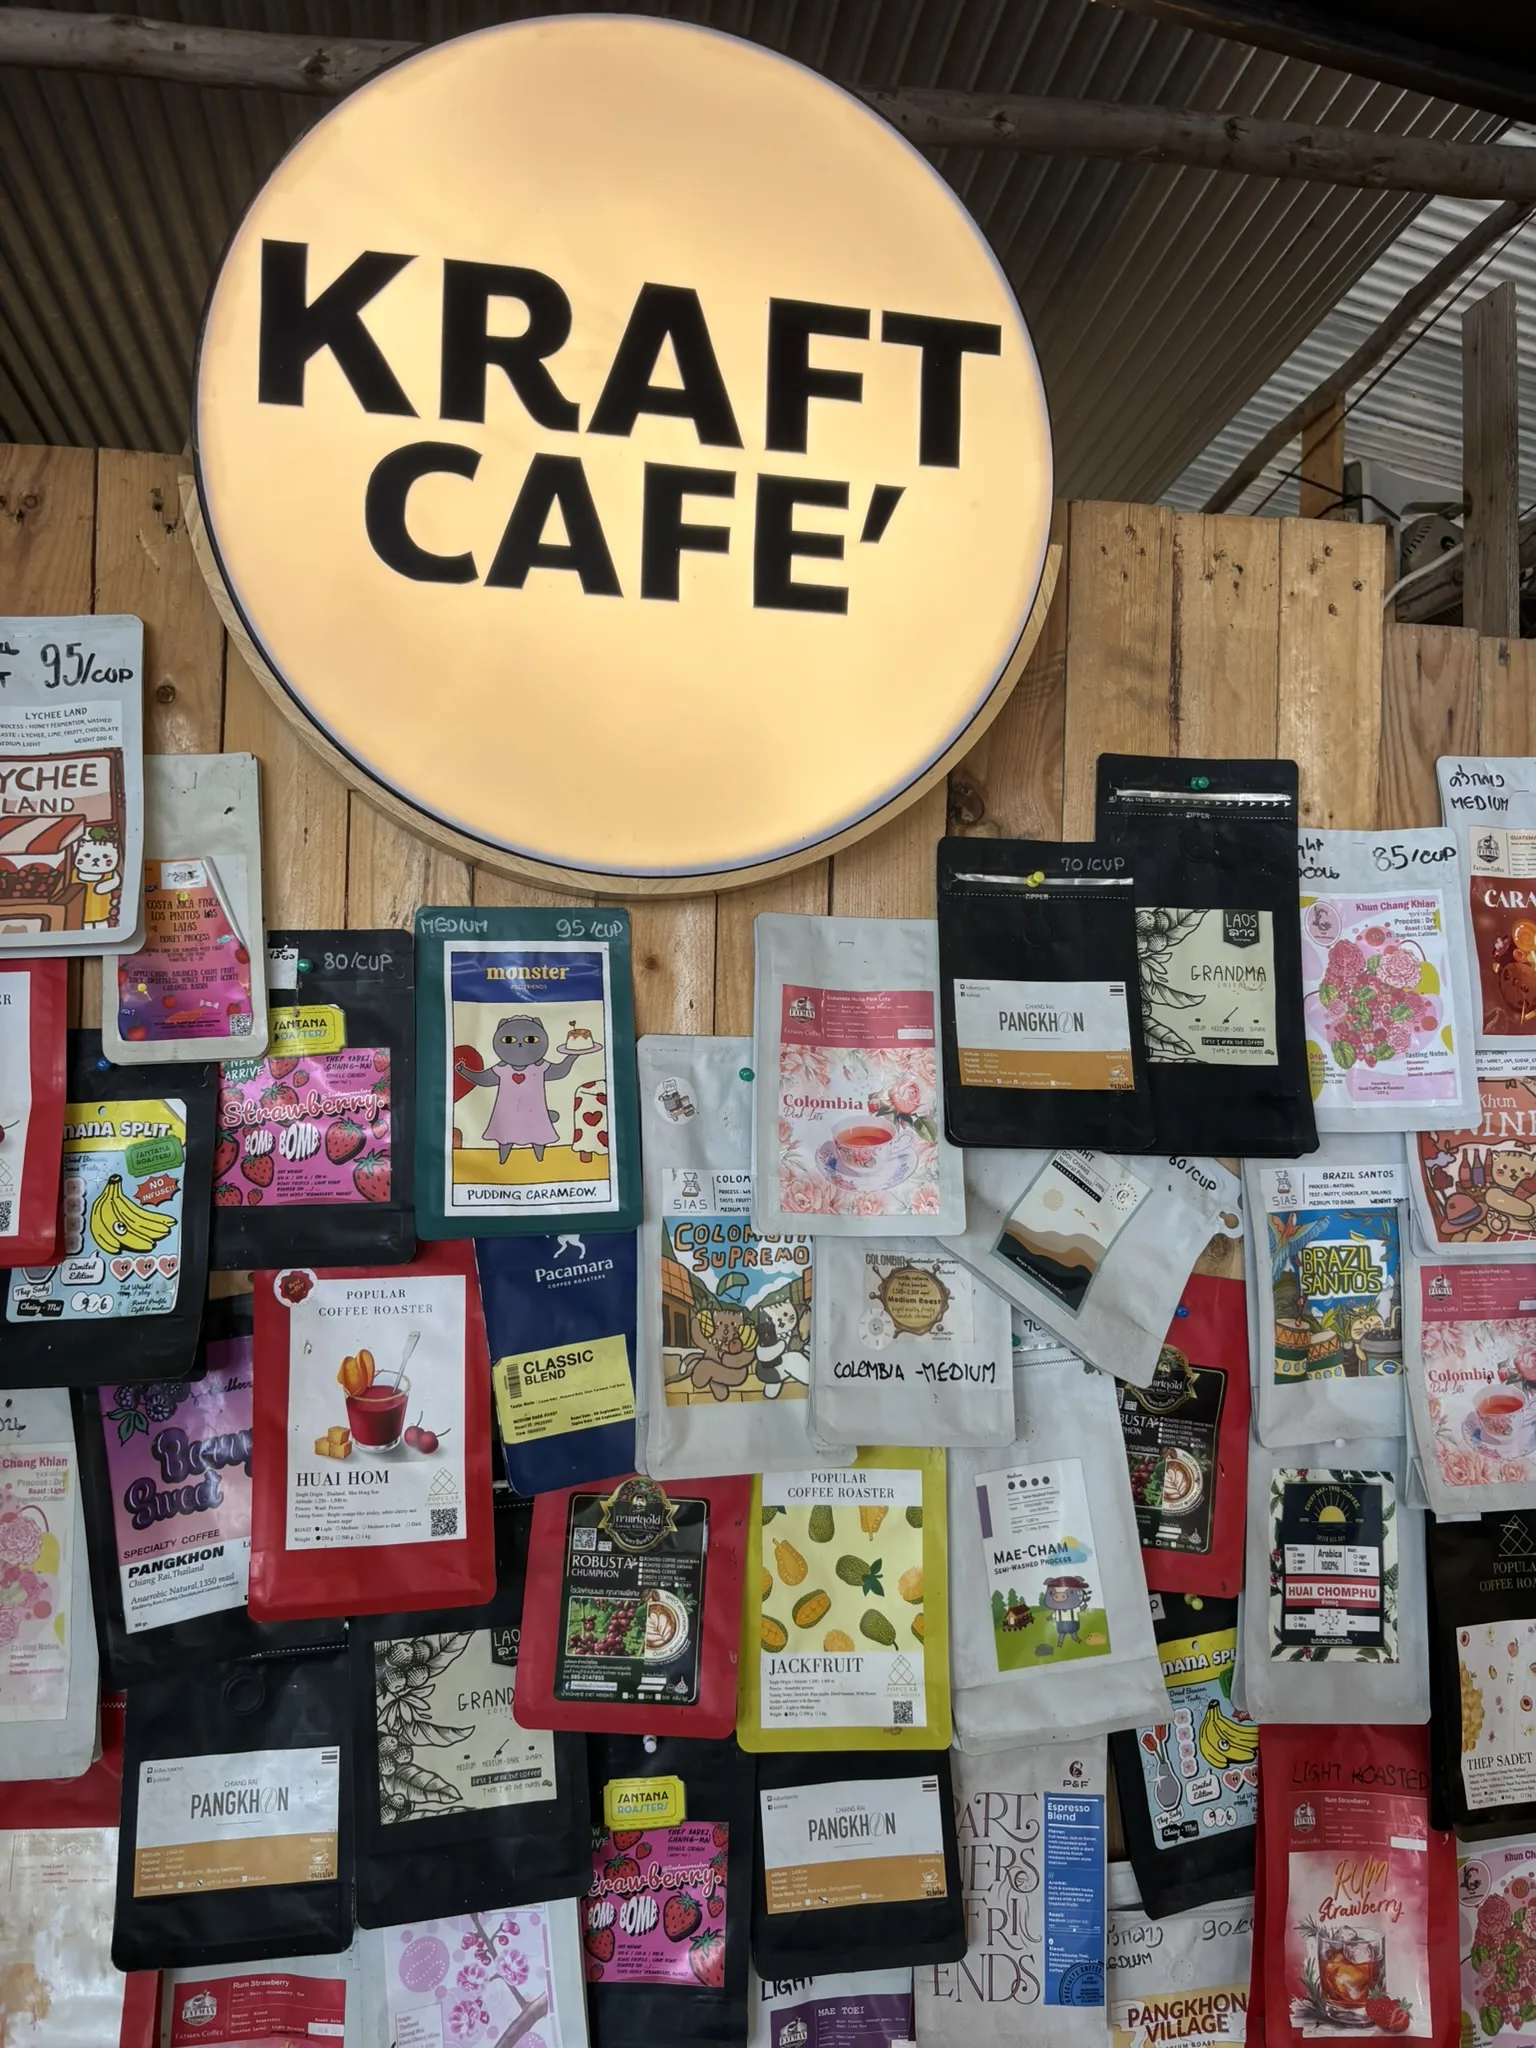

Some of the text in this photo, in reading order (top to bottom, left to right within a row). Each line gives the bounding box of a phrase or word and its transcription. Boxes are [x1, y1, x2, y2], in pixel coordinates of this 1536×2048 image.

[257, 237, 1002, 469] KRAFT
[364, 440, 907, 615] CAFE'
[40, 642, 134, 689] 95/CUP
[25, 707, 88, 720] LYCHEE LAND
[0, 763, 98, 793] YCHEE
[1, 797, 75, 815] LAND
[1451, 795, 1509, 812] MEDIUM
[1356, 900, 1436, 912] Khun Chang Khian
[420, 919, 488, 934] MEDIUM
[1226, 914, 1257, 929] LAOS
[1394, 918, 1421, 926] Process
[324, 952, 393, 973] 80/CUP
[486, 964, 570, 981] monster
[1191, 965, 1267, 982] GRANDMA
[1429, 1050, 1449, 1058] Notes
[225, 1065, 264, 1081] ARRIVE
[783, 1093, 864, 1111] Colombia
[120, 1120, 171, 1138] SPLIT
[1322, 1170, 1394, 1180] BRAZIL SANTOS
[149, 1178, 165, 1188] NO
[467, 1187, 522, 1201] PUDDING
[1272, 1195, 1298, 1206] SIAS
[673, 1199, 708, 1211] SIAS
[673, 1223, 814, 1252] COLOM
[692, 1246, 810, 1272] SUPREMO
[866, 1254, 906, 1267] COLOMBIA
[1302, 1247, 1380, 1274] BRAZIL
[69, 1261, 96, 1273] Limited
[535, 1258, 614, 1283] Pacamara
[69, 1271, 95, 1281] Edition
[548, 1273, 606, 1289] COFFEE ROASTERS
[1301, 1271, 1382, 1295] SANTOS
[346, 1289, 406, 1301] POPULAR
[888, 1296, 941, 1305] Medium Roast
[318, 1304, 433, 1317] COFFEE ROASTER
[523, 1349, 594, 1375] CLASSIC
[524, 1369, 566, 1386] BLEND
[1428, 1367, 1495, 1384] Colombia
[2, 1456, 68, 1469] Chang Khian
[296, 1470, 390, 1487] HUAI HOM
[811, 1473, 867, 1484] POPULAR
[788, 1487, 895, 1499] COFFEE ROASTER
[123, 1528, 220, 1559] SPECIALTY COFFEE
[1318, 1549, 1343, 1558] Arabica
[128, 1545, 225, 1579] PANGKHON
[572, 1554, 633, 1570] ROBUSTA
[1321, 1560, 1339, 1571] 100%
[1493, 1561, 1536, 1575] POPULA
[571, 1567, 620, 1578] CHUMPHON
[129, 1576, 156, 1589] Chiang
[1479, 1579, 1514, 1592] COFFEE
[131, 1588, 168, 1605] Anaerobic
[1288, 1586, 1377, 1598] HUAI CHOMPHU
[493, 1628, 520, 1643] LAO
[769, 1657, 864, 1676] JACKFRUIT
[458, 1686, 514, 1711] GRAND
[1467, 1751, 1533, 1771] THEP SADET
[1291, 1762, 1342, 1784] LIGHT
[1191, 1780, 1213, 1792] Limited
[617, 1790, 668, 1804] SANTANA
[1193, 1789, 1214, 1800] Edition
[617, 1802, 668, 1815] ROASTERS
[1047, 1802, 1090, 1814] Espresso
[1047, 1811, 1077, 1821] Blend
[1504, 1852, 1524, 1862] Khun
[588, 1861, 721, 1897] trawberry.
[1107, 1952, 1152, 1970] EDIUM
[232, 1979, 290, 1989] Rum Strawberry
[818, 2006, 865, 2016] MAE TOEI
[1127, 1992, 1248, 2028] PANGKHON
[1145, 2013, 1230, 2043] VILLAGE
